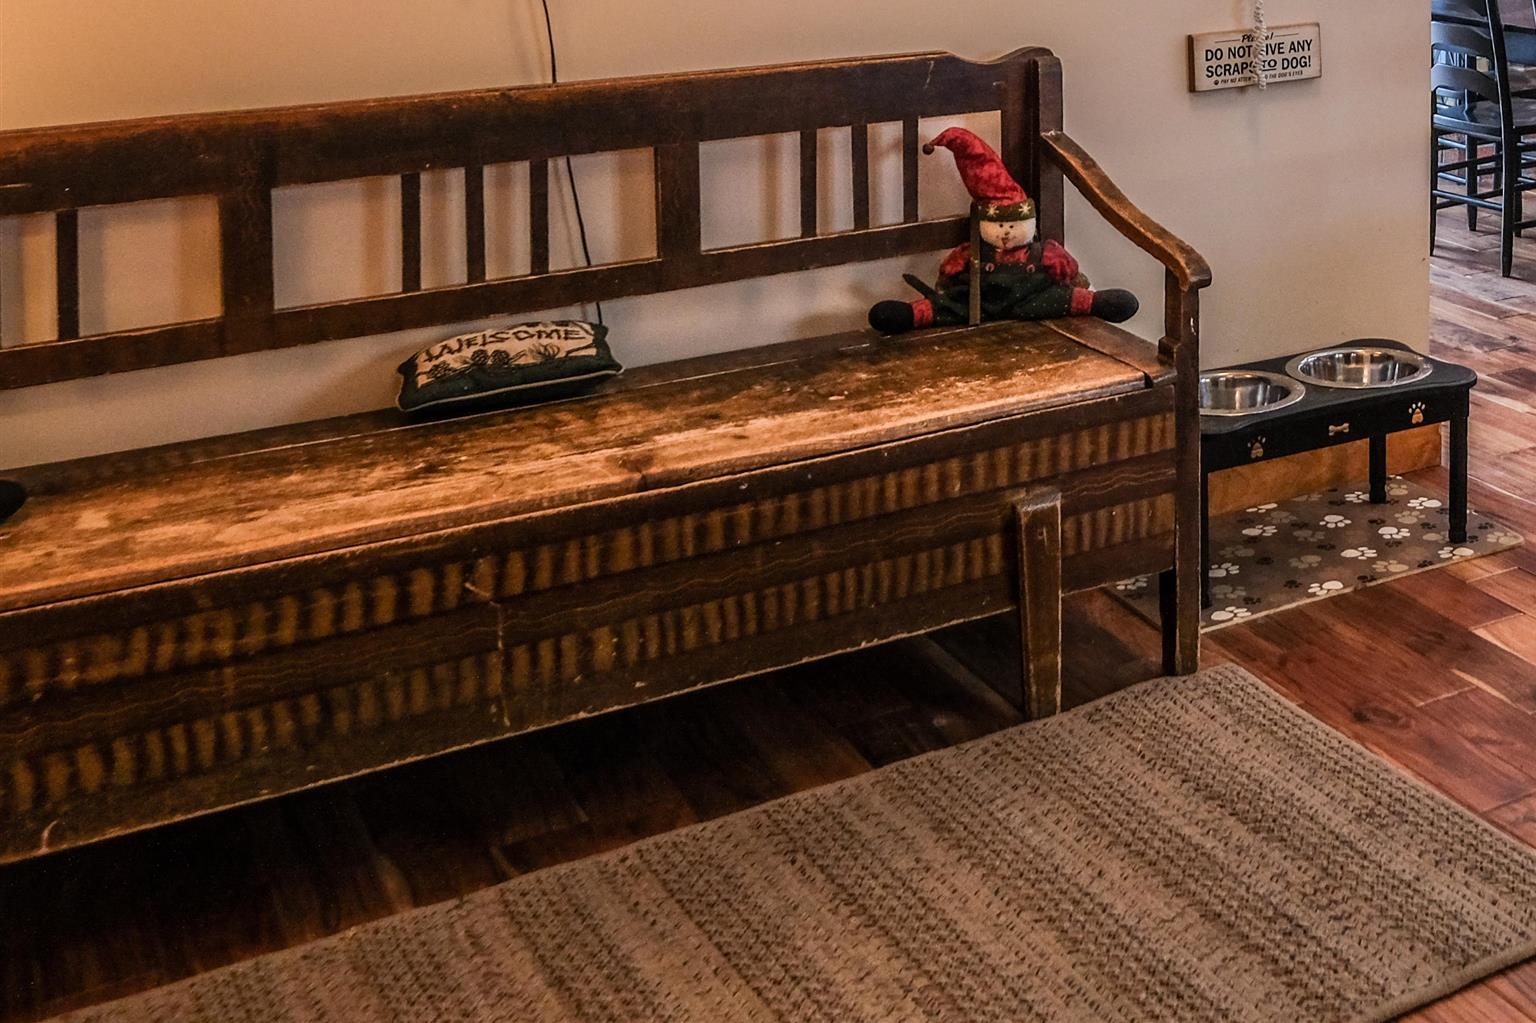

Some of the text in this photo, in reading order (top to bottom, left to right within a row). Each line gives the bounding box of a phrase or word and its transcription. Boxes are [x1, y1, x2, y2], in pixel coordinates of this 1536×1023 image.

[1205, 38, 1313, 62] DO NOT IVE ANY
[1281, 55, 1312, 71] DOG!
[423, 327, 588, 363] WELCOME
